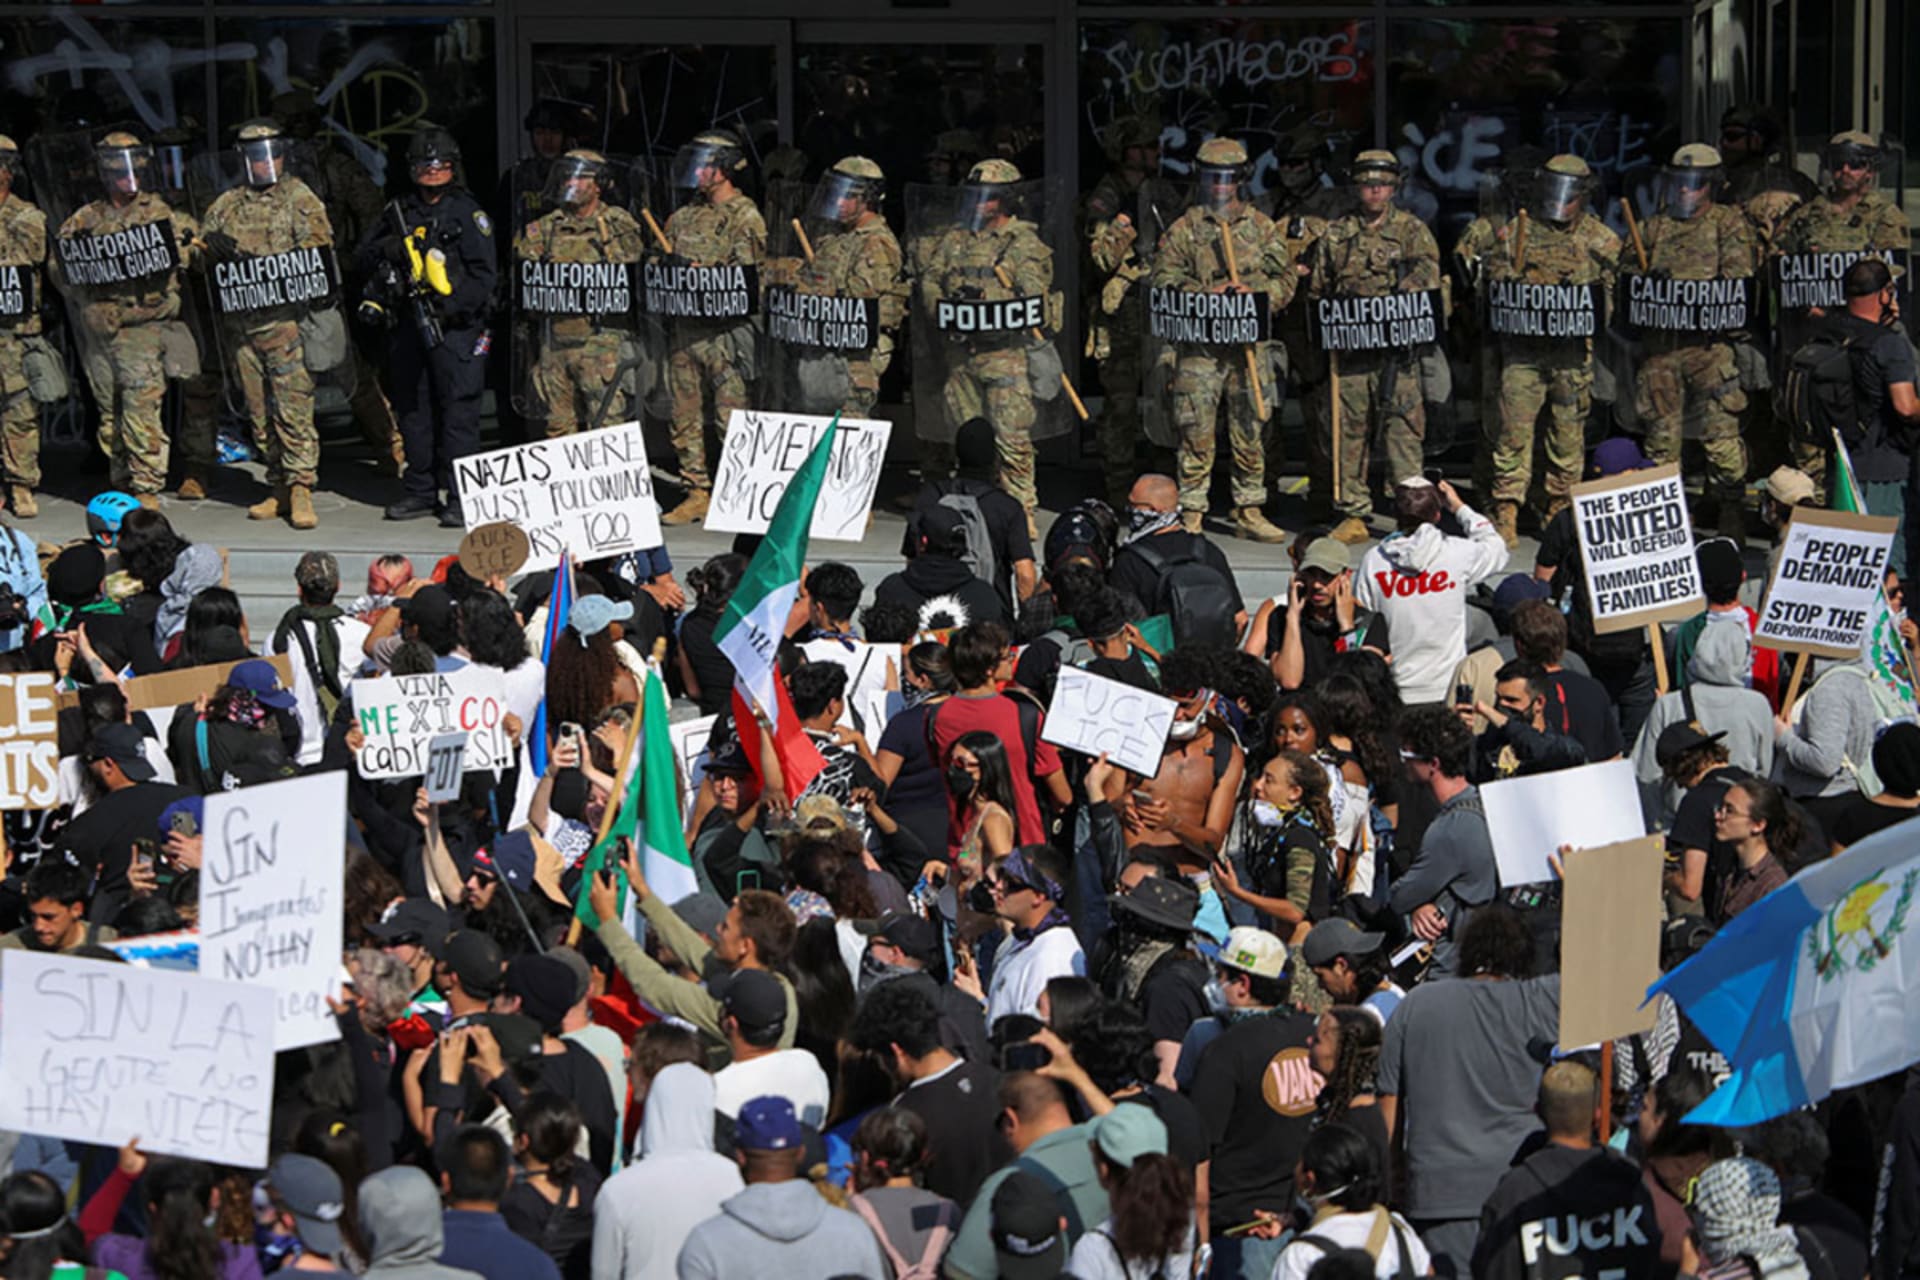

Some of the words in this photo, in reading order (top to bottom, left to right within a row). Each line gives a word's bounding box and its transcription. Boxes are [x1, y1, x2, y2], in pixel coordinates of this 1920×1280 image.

[59, 223, 166, 262] CALIFORNIA
[64, 254, 124, 287] NATIONAL
[124, 246, 171, 280] GUARD
[215, 245, 326, 287] CALIFORNIA
[522, 261, 629, 288] CALIFORNIA
[644, 263, 747, 292] CALIFORNIA
[220, 279, 286, 313] NATIONAL
[285, 272, 329, 302] GUARD
[522, 287, 583, 314] NATIONAL
[585, 288, 630, 315] GUARD
[645, 288, 702, 318] NATIONAL
[703, 290, 749, 318] GUARD
[768, 288, 867, 323] CALIFORNIA
[1149, 286, 1257, 318] CALIFORNIA
[1488, 281, 1593, 310] CALIFORNIA
[1629, 275, 1745, 305] CALIFORNIA
[1781, 280, 1847, 308] NATIONAL
[937, 298, 1043, 331] POLICE
[1318, 291, 1434, 325] CALIFORNIA
[1489, 306, 1545, 336] NATIONAL
[1546, 310, 1594, 337] GUARD
[1629, 299, 1697, 330] NATIONAL
[1700, 303, 1746, 331] GUARD
[769, 312, 822, 348] NATIONAL
[823, 320, 868, 350] GUARD
[1151, 312, 1210, 344] NATIONAL
[1211, 317, 1259, 344] GUARD
[1320, 321, 1389, 351] NATIONAL
[1389, 316, 1436, 347] GUARD
[563, 431, 644, 471] WERE
[748, 480, 785, 521] IC
[1580, 495, 1616, 518] THE
[1617, 482, 1679, 511] PEOPLE
[577, 510, 633, 551] TOO
[1583, 502, 1684, 547] UNITED
[471, 545, 513, 570] ICE
[1588, 543, 1628, 564] WILL
[1629, 529, 1688, 556] DEFEND
[1803, 539, 1887, 569] PEOPLE
[1374, 569, 1457, 599] Vote.
[1593, 555, 1693, 594] IMMIGRANT
[1781, 558, 1879, 591] DEMAND:
[1596, 575, 1698, 615] FAMILIES!
[1762, 621, 1861, 645] DEPORTATIONS!
[1767, 600, 1823, 625] STOP
[1827, 607, 1868, 632] THE
[396, 675, 455, 698] VIVA
[360, 696, 500, 736] MEXICO
[1062, 674, 1169, 745] FUCK
[1066, 718, 1149, 768] ICE
[35, 967, 155, 1042] SIN
[170, 988, 256, 1060] LA
[199, 1064, 259, 1092] NO
[1686, 1050, 1732, 1074] THE
[24, 1085, 111, 1138] HAY
[1520, 1203, 1649, 1266] FUCK
